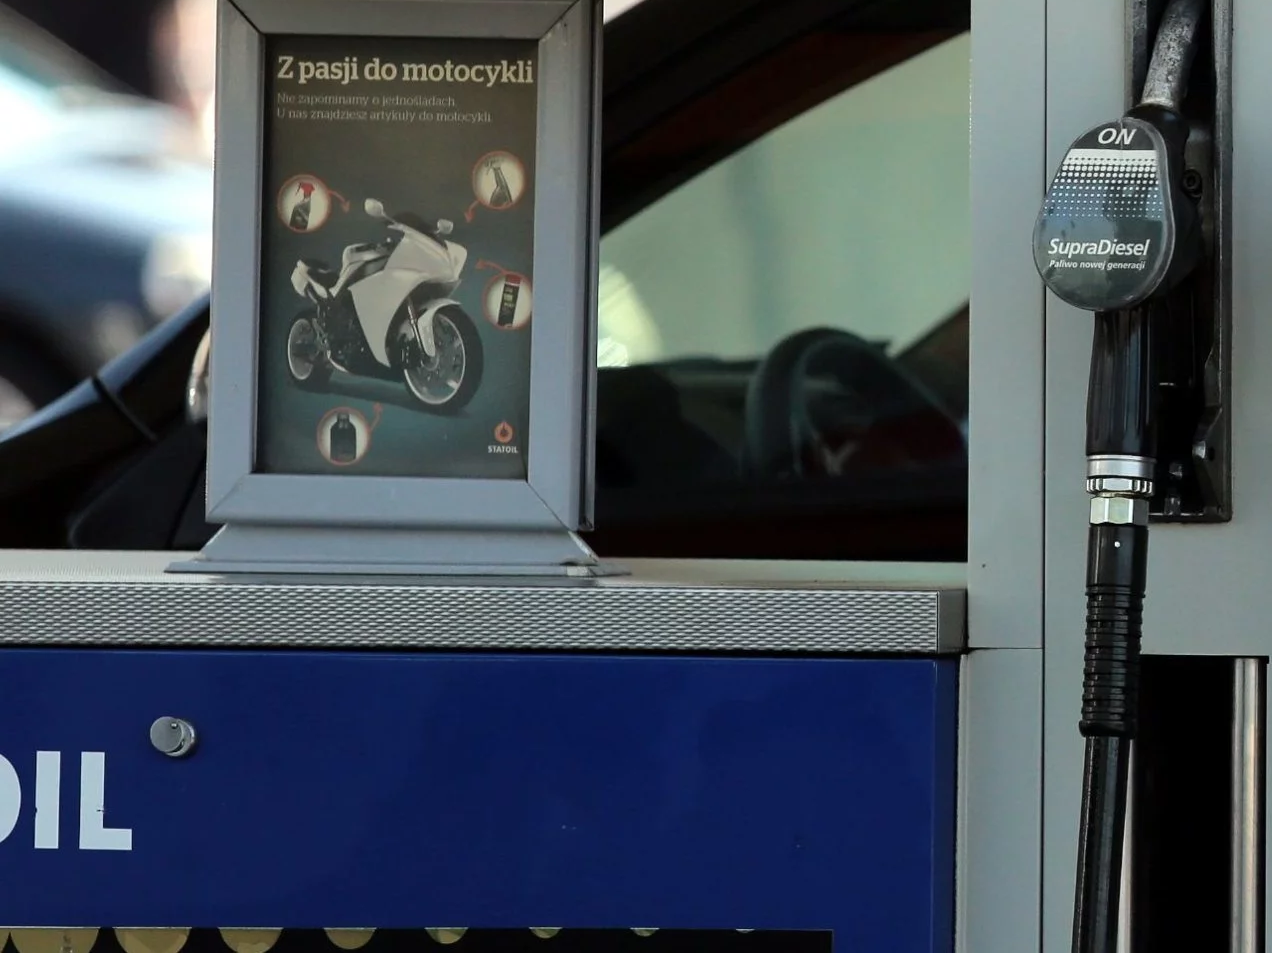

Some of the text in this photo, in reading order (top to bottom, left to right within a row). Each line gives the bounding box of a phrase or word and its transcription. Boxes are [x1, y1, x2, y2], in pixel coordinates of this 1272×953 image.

[278, 56, 533, 87] Z pasji do motocykli
[1098, 128, 1137, 145] ON
[1048, 238, 1150, 258] SupraDiesel
[1049, 259, 1146, 270] Paliwo nowej generacji
[487, 445, 518, 454] STATOIL
[0, 750, 132, 850] IL
